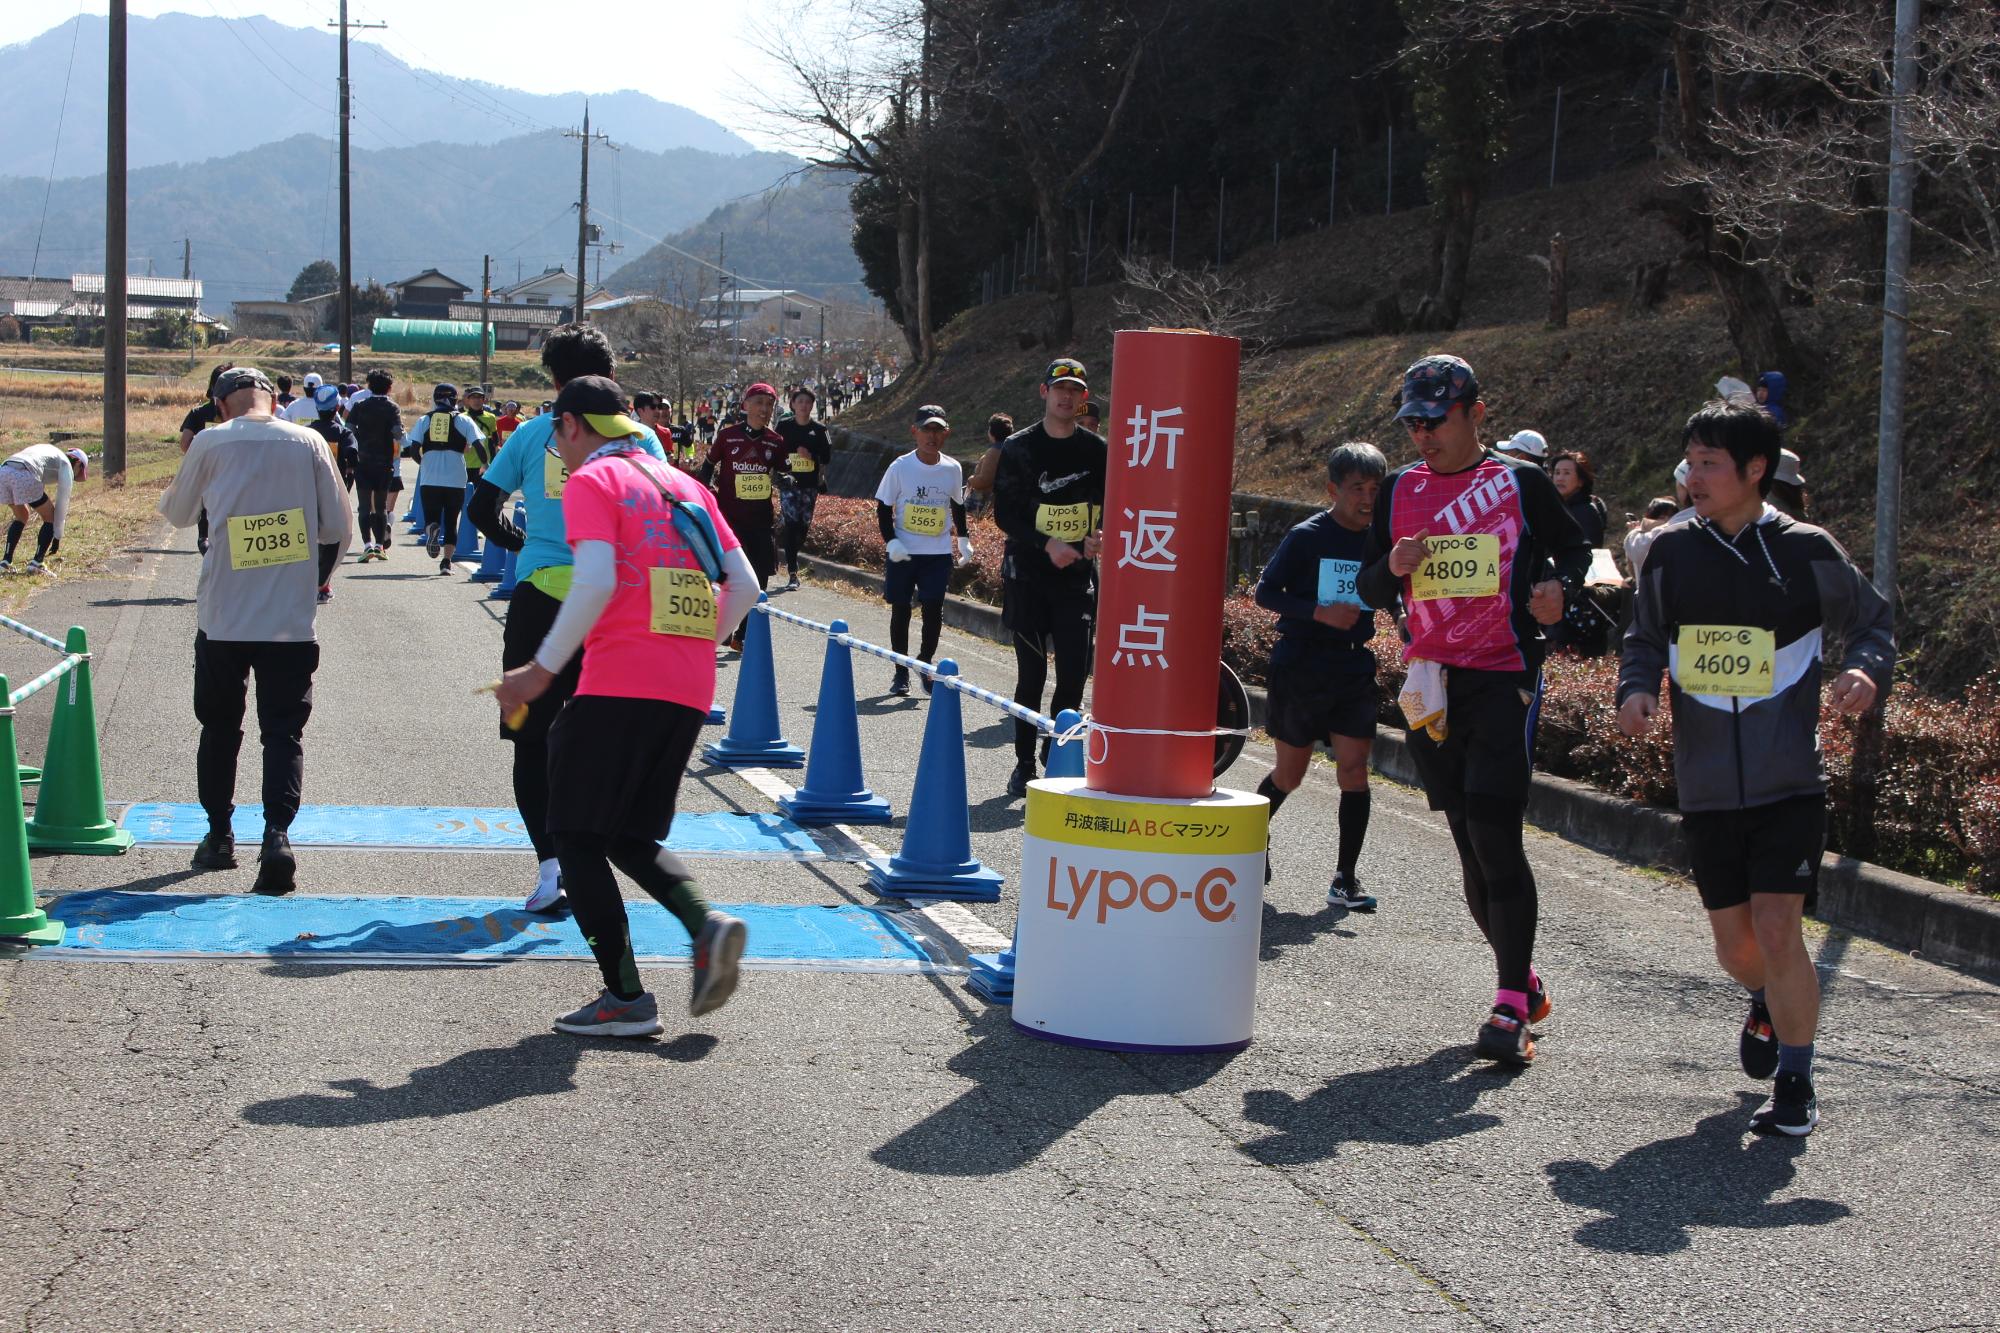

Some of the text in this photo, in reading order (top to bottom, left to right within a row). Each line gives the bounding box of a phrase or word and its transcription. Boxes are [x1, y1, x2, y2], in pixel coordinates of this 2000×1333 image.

[732, 461, 768, 473] Rakuten
[741, 484, 763, 492] 5469
[244, 513, 289, 531] Lypo-C
[911, 516, 936, 527] 5565
[1045, 520, 1079, 531] 5195
[243, 533, 305, 553] 7038 C
[1111, 404, 1185, 670] 折返点
[1423, 559, 1496, 581] 4809 A
[669, 594, 710, 619] 5029
[1696, 629, 1752, 646] Lypo-C
[1694, 654, 1770, 675] 4609 A
[1065, 812, 1230, 838] 丹波篠山ABCマラソン
[1047, 856, 1237, 924] Lypo-C
